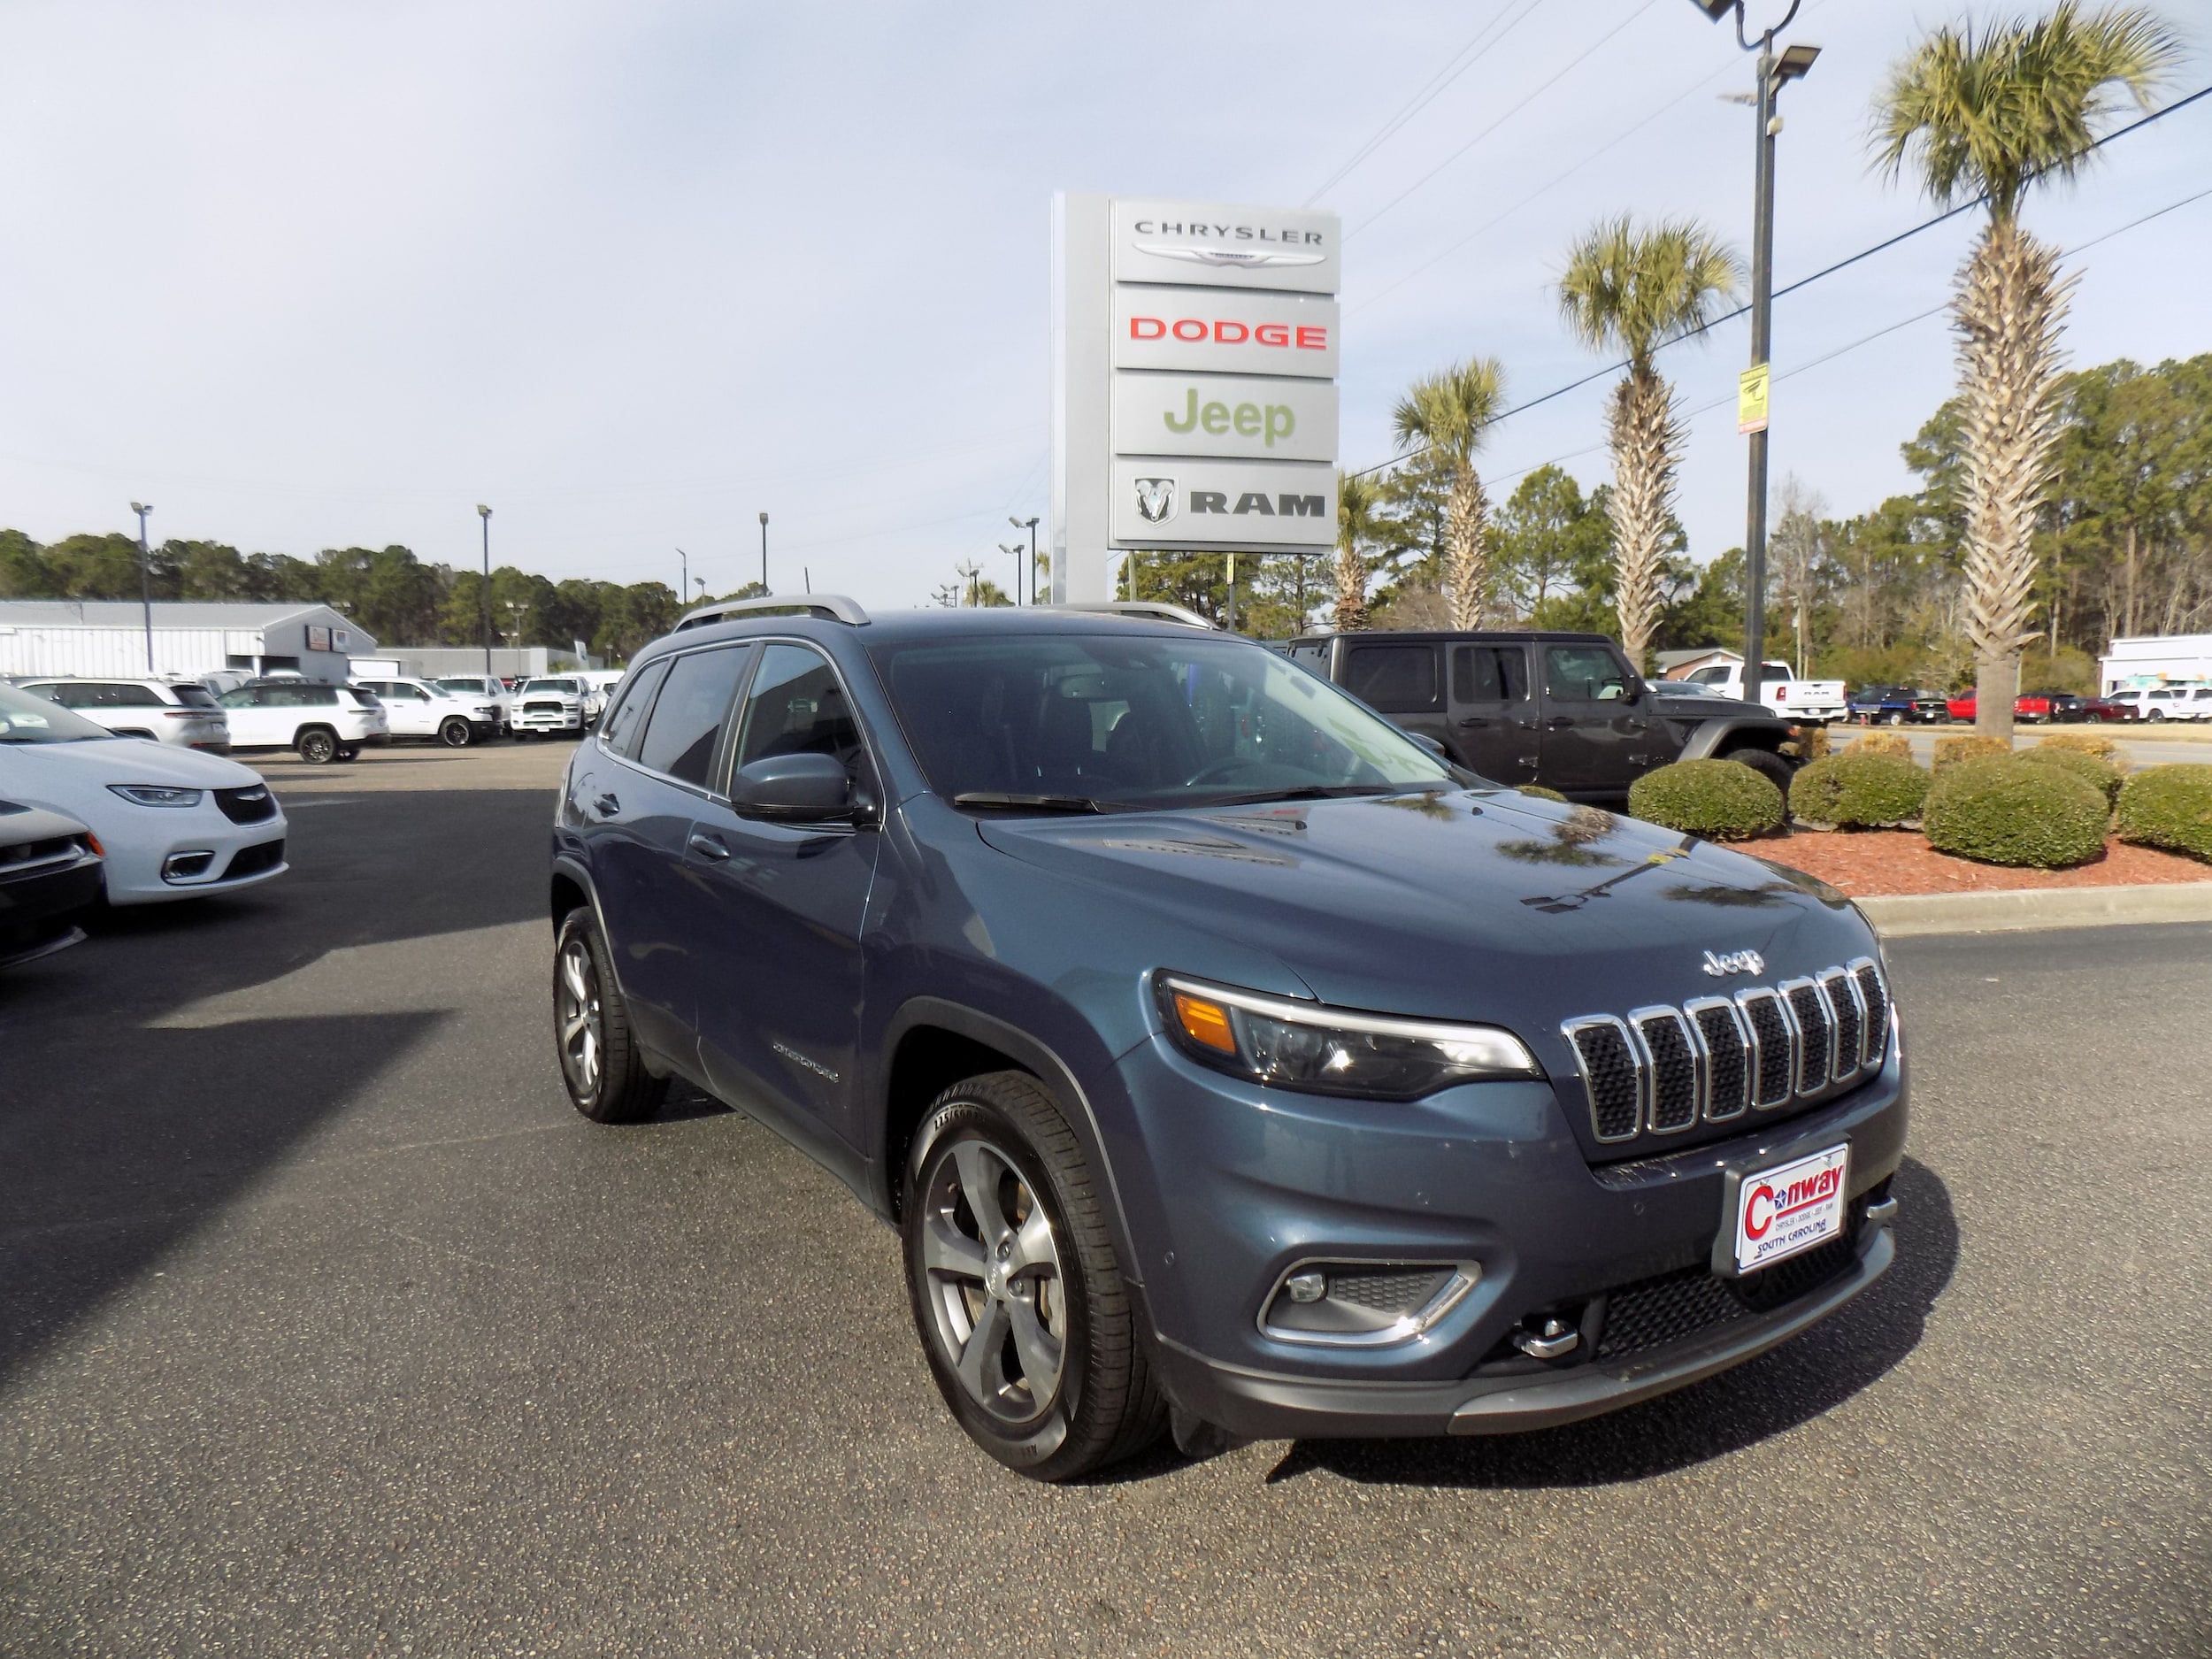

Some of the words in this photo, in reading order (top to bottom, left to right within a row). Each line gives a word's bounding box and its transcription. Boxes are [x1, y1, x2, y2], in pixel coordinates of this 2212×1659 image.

[1134, 221, 1323, 246] CHRYSLER
[1130, 317, 1327, 351] DODGE
[1164, 388, 1296, 448] Jeep
[1190, 491, 1325, 518] RAM
[1703, 949, 1765, 978] Jeep
[1757, 1234, 1786, 1255] SOUTH
[1788, 1218, 1827, 1241] CAROLINA
